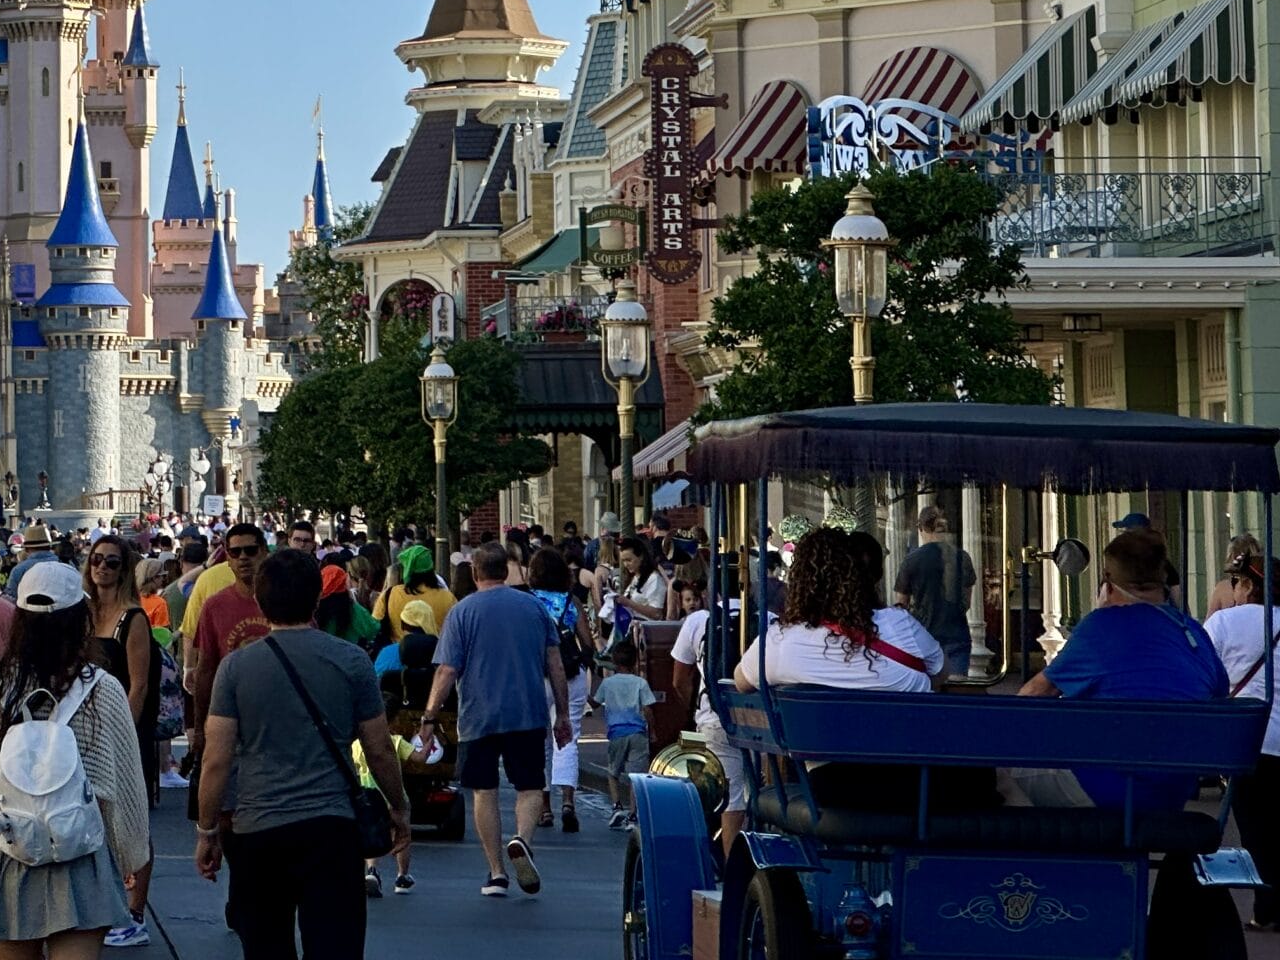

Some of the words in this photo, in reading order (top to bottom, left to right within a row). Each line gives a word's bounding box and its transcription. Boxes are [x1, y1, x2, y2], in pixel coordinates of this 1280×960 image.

[660, 77, 683, 177] CRYSTAL
[661, 193, 684, 251] ARTS
[593, 252, 634, 264] COFFEE
[437, 296, 449, 332] ICE
